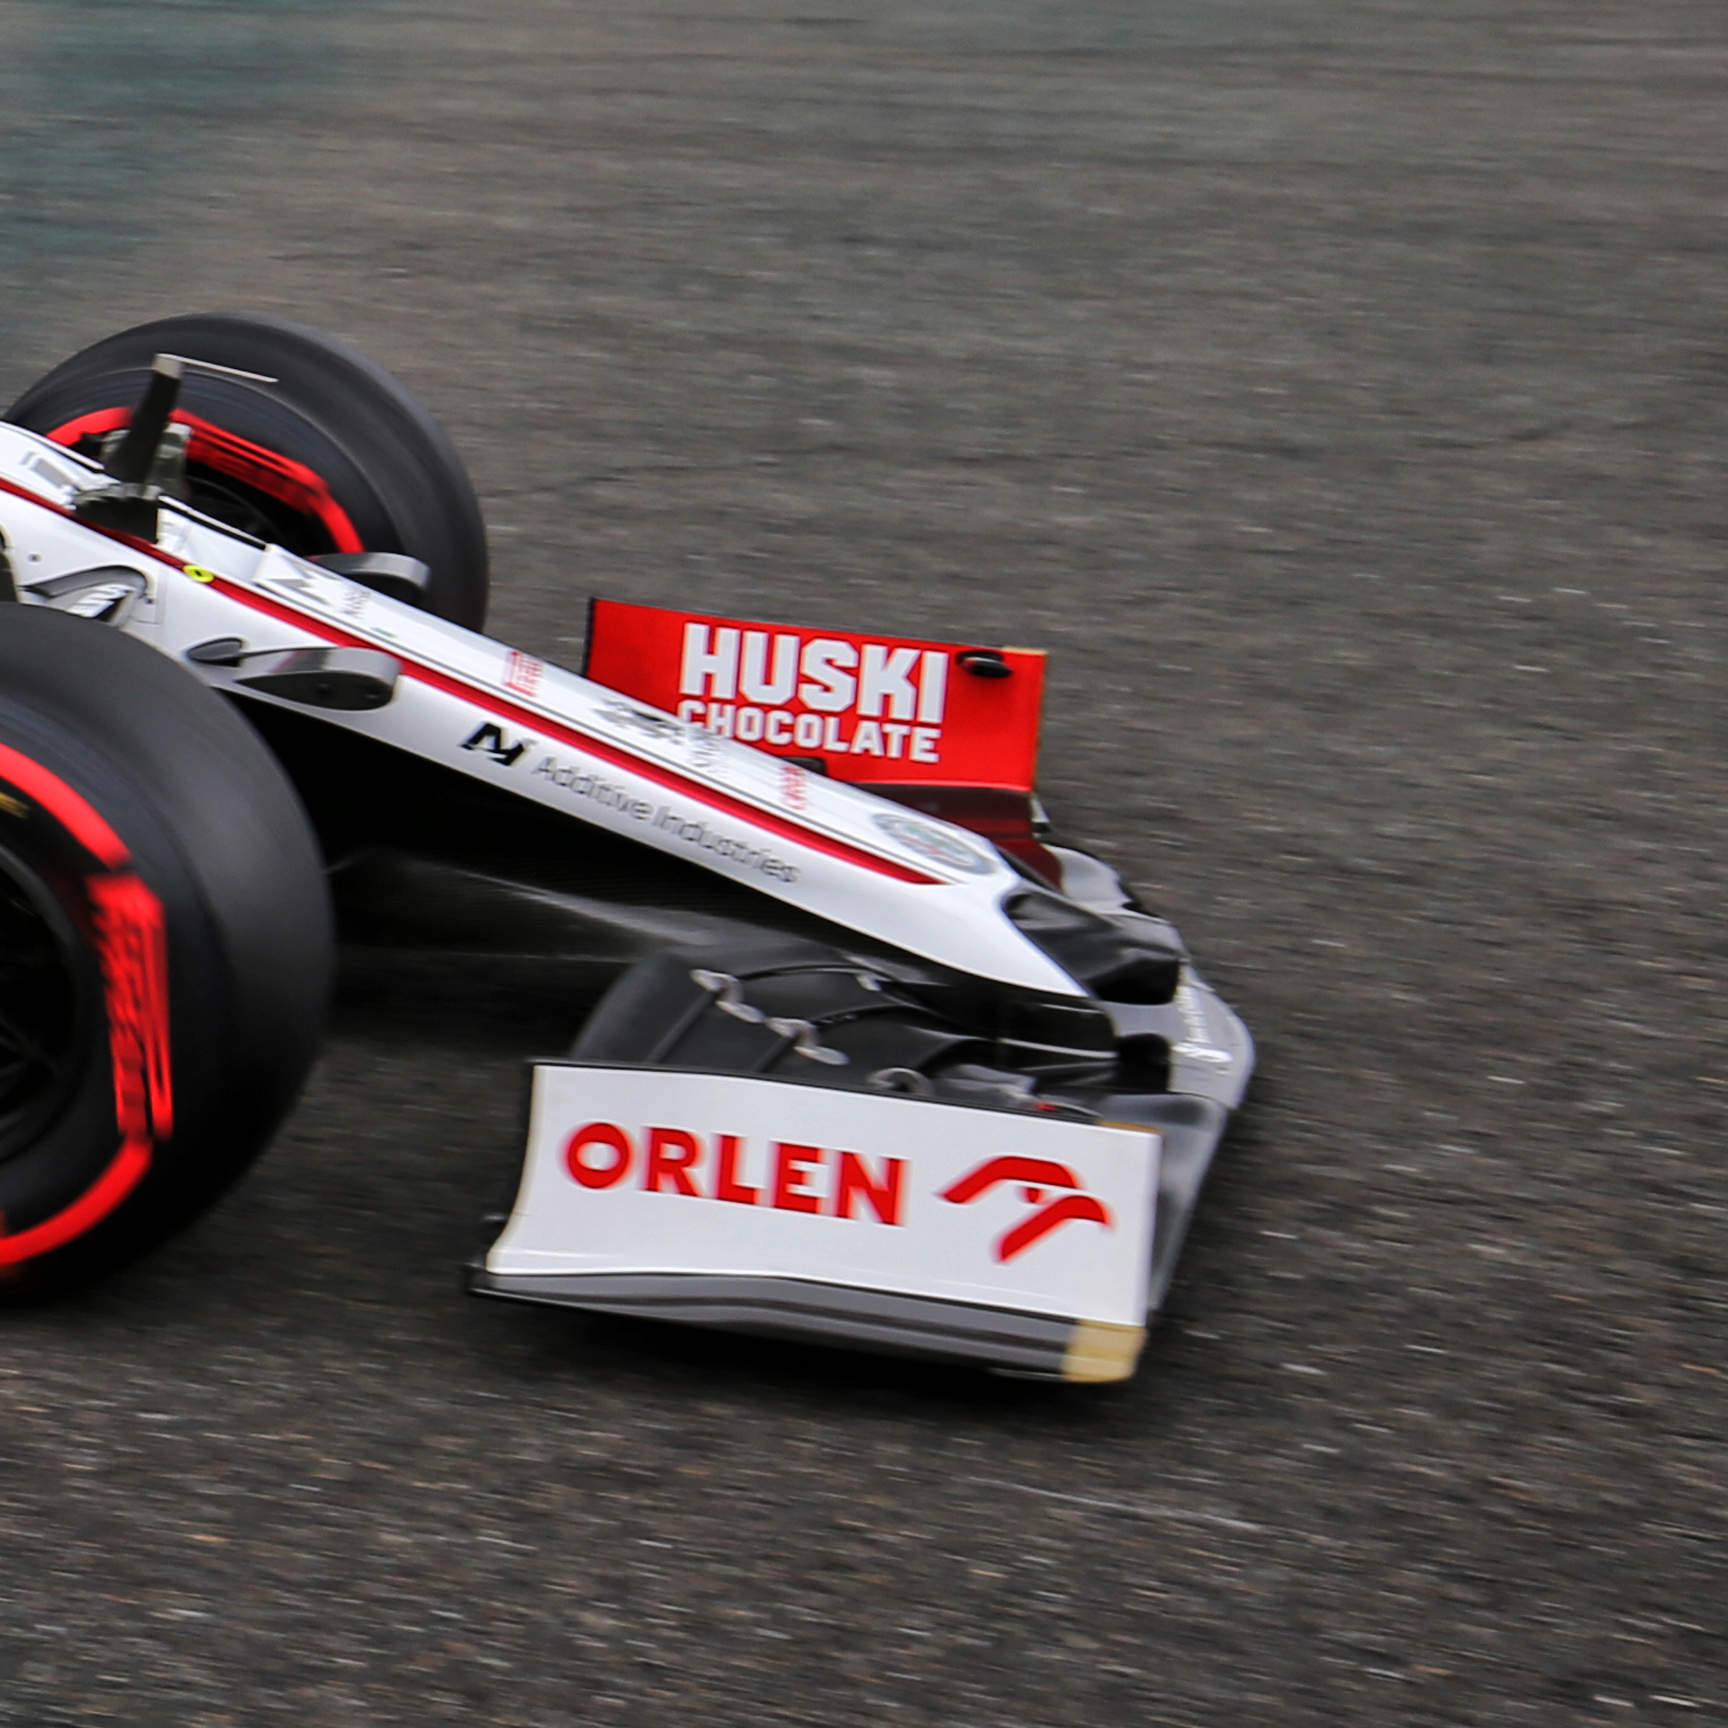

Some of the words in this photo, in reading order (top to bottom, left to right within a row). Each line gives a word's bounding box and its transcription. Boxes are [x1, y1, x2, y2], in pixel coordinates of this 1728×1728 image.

[678, 619, 948, 724] HUSKI
[676, 699, 942, 764] CHOCOLATE
[532, 756, 654, 822] Additive
[652, 805, 800, 883] Industries
[563, 1121, 910, 1228] ORLEN
